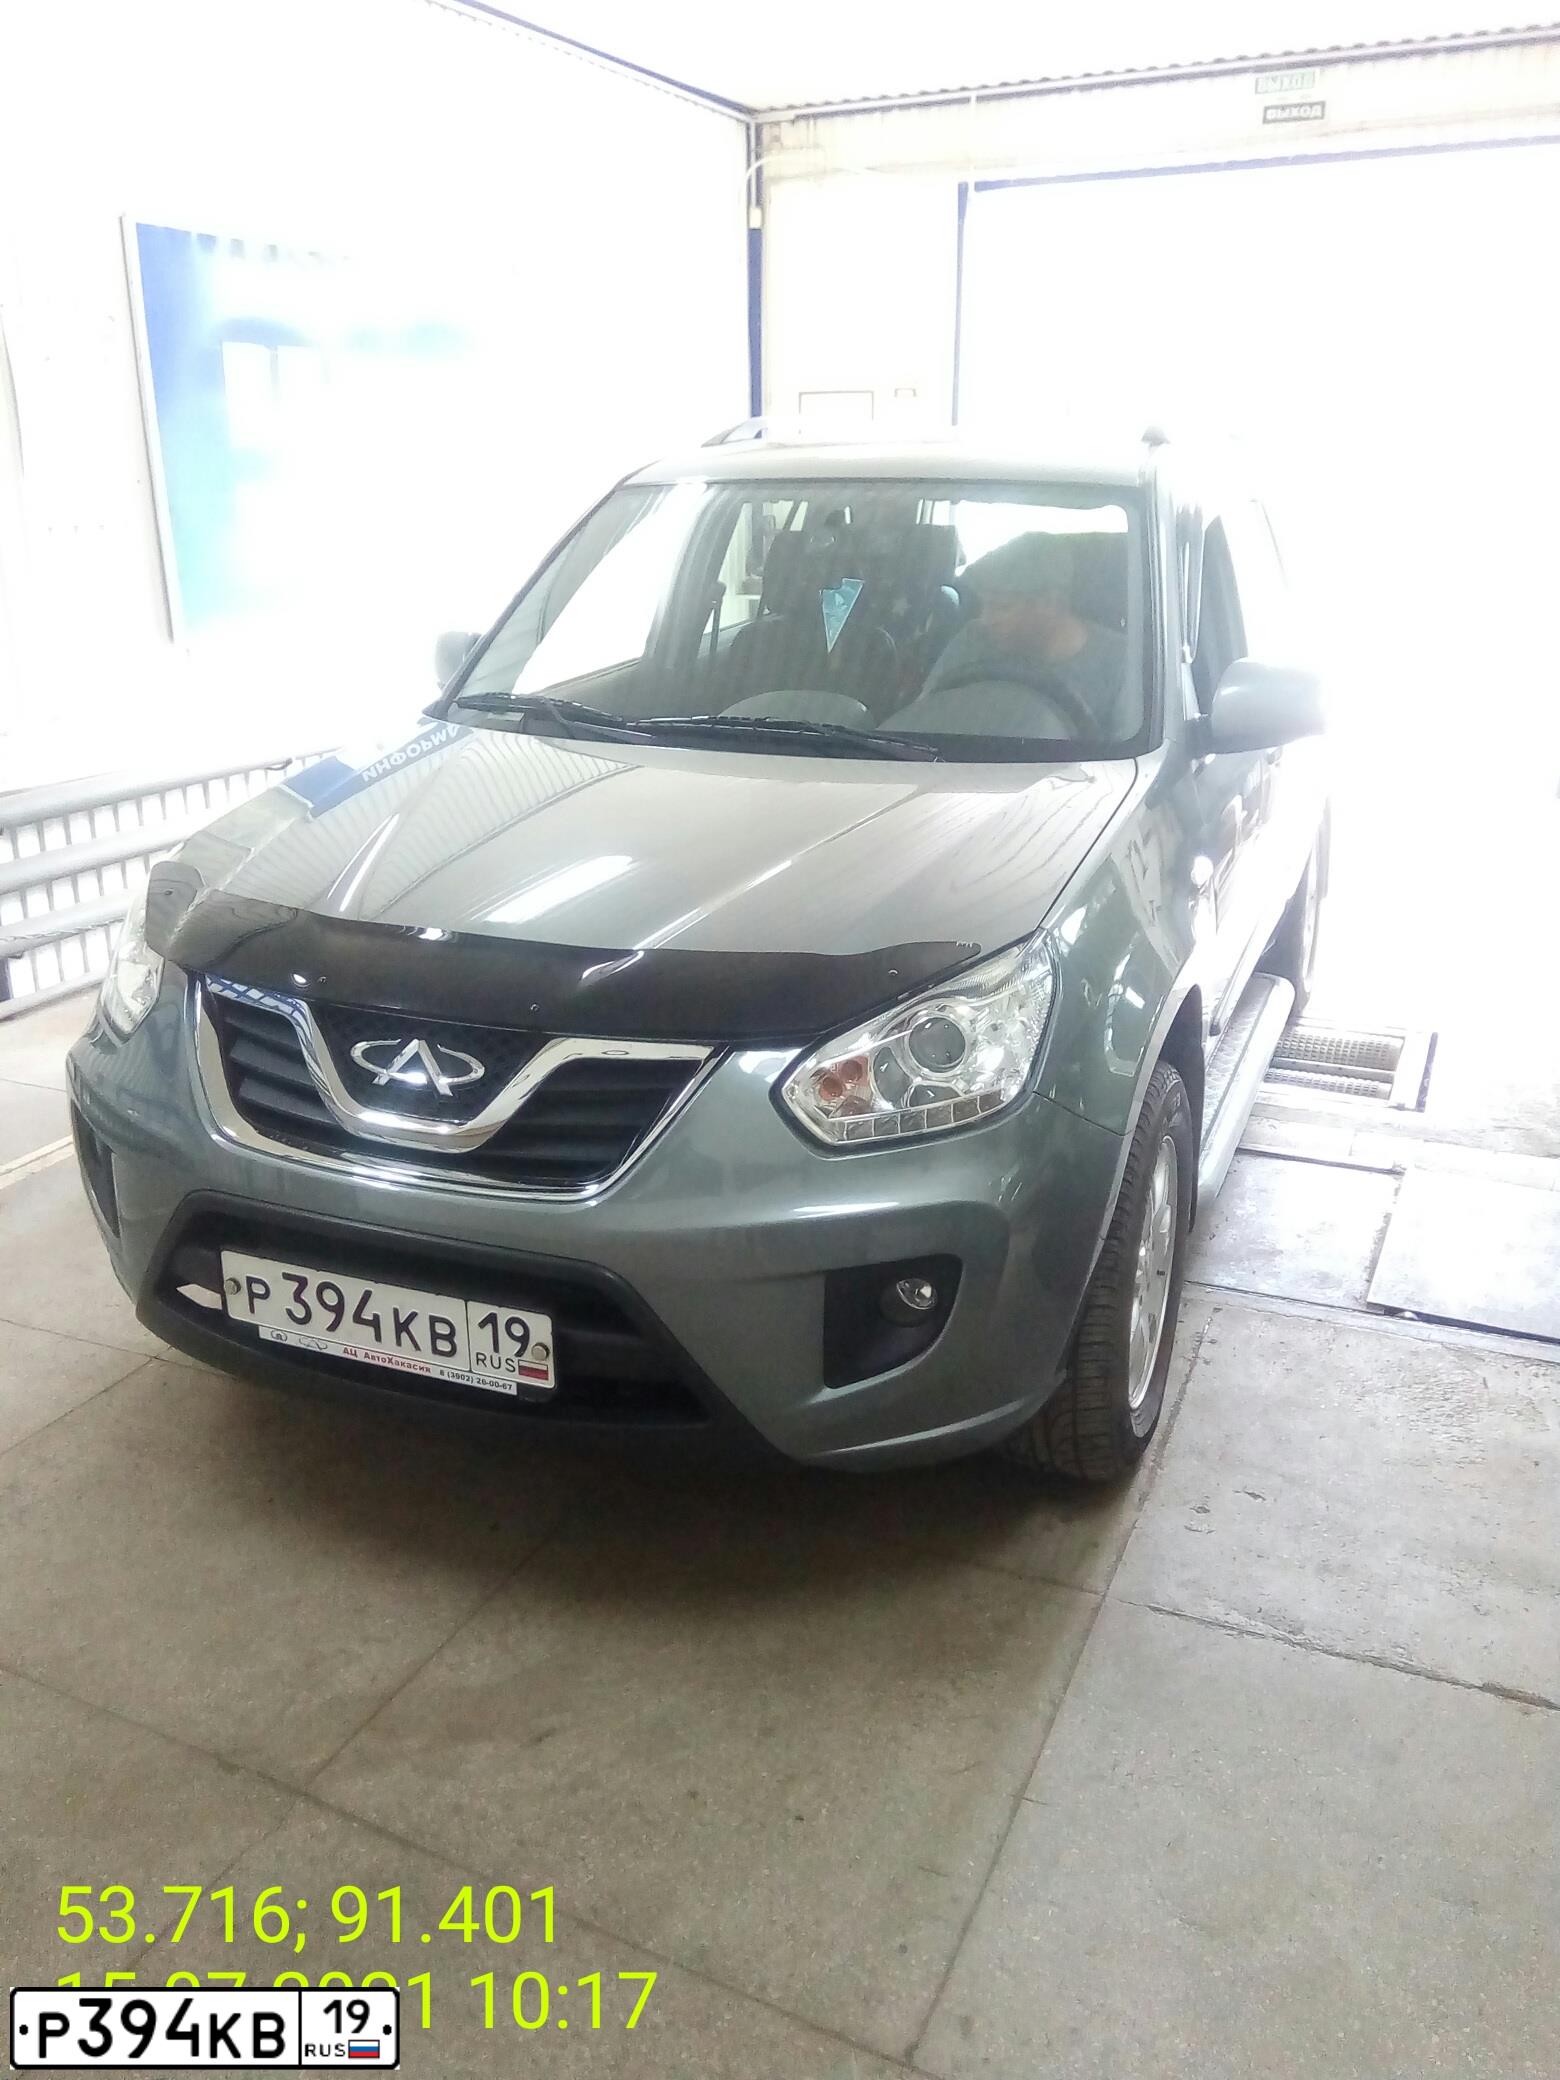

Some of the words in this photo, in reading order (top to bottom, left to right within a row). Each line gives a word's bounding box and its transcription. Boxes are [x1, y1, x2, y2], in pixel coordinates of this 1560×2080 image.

[478, 1312, 530, 1358] 19
[343, 1346, 358, 1358] АЦ
[364, 1351, 431, 1373] АвтоХакасия
[475, 1352, 516, 1373] RUS
